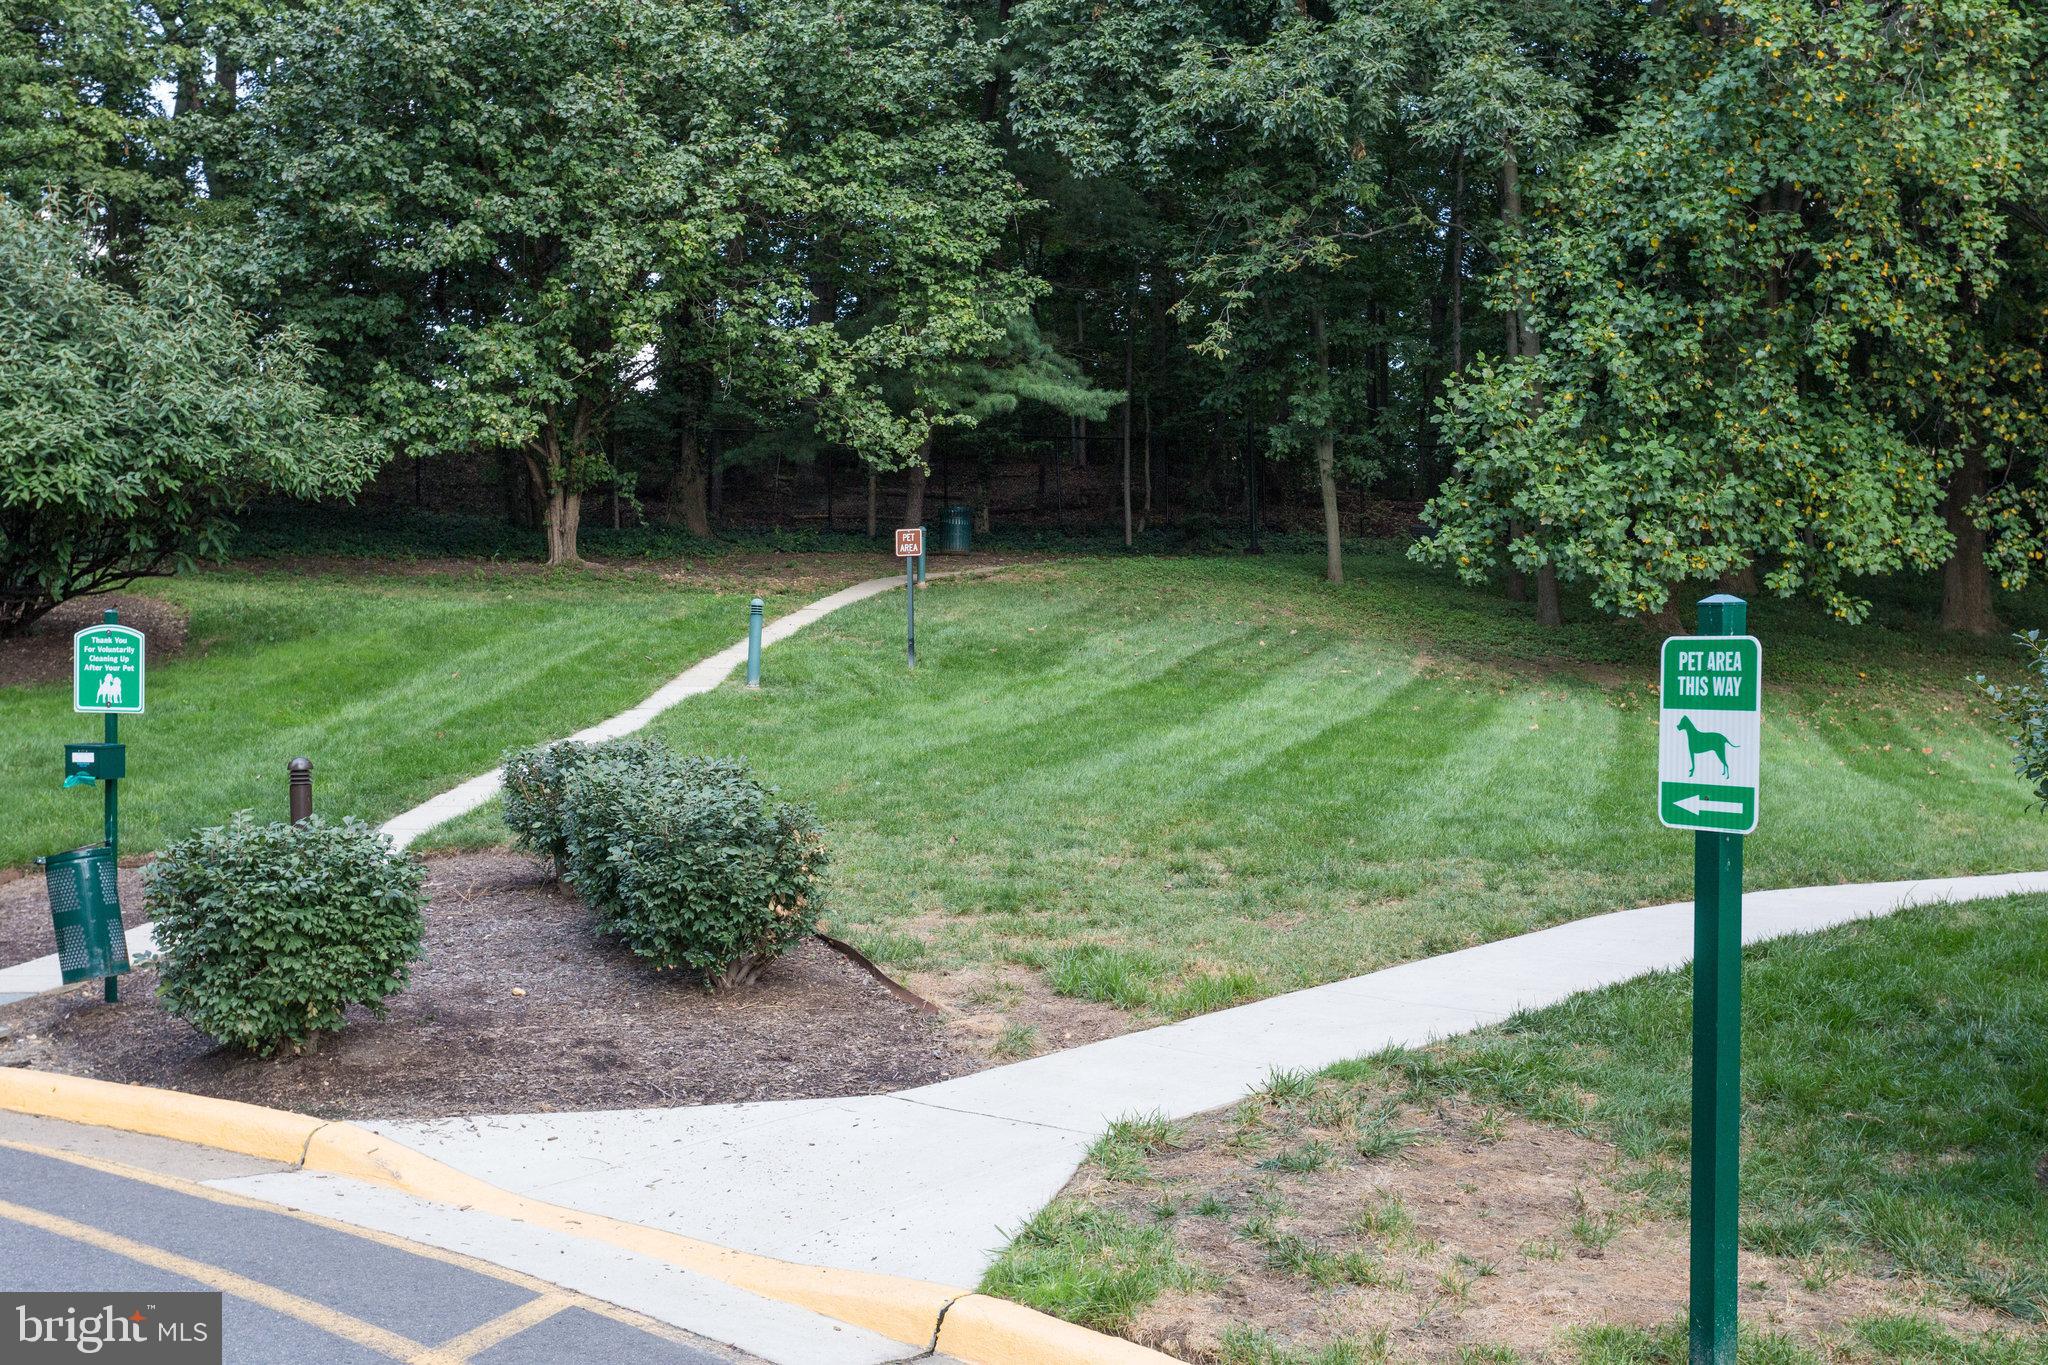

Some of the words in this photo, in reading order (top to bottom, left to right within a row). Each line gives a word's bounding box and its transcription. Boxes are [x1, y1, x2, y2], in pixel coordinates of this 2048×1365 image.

[902, 533, 915, 542] PET
[900, 543, 918, 552] AREA
[91, 636, 112, 644] Thank
[114, 636, 128, 644] You
[97, 646, 135, 655] Voluntarily
[89, 655, 118, 663] Cleaning
[120, 655, 130, 663] Up
[1678, 651, 1704, 672] PET
[1707, 651, 1742, 672] AREA
[1678, 676, 1709, 696] THIS
[1713, 676, 1742, 697] WAY
